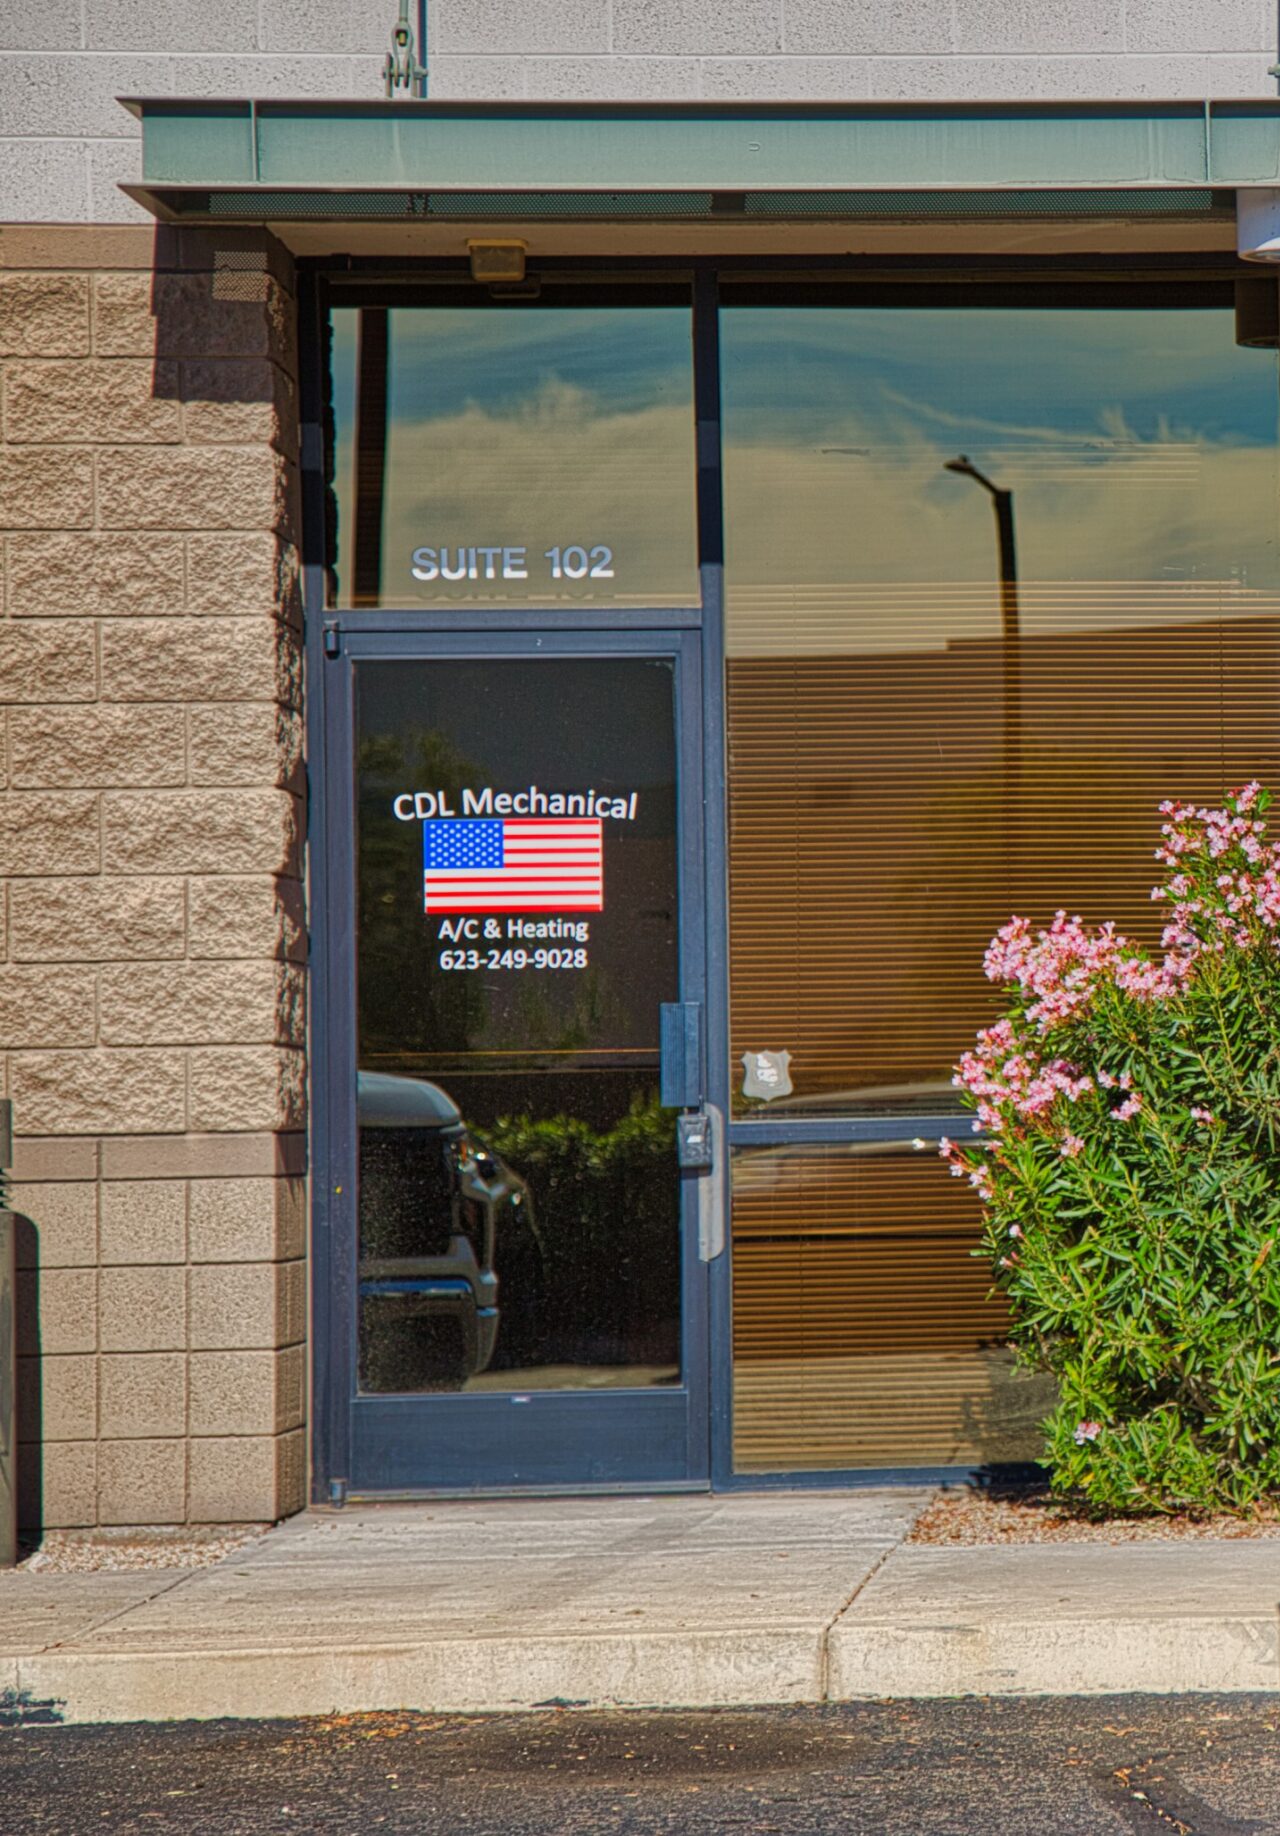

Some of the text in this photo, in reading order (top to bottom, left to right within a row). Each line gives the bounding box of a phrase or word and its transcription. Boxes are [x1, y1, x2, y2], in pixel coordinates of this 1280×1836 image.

[411, 545, 615, 581] SUITE 102
[393, 785, 638, 820] CDL Mechanical
[438, 917, 589, 943] A/C & Heating
[439, 949, 588, 970] 623-249-9028
